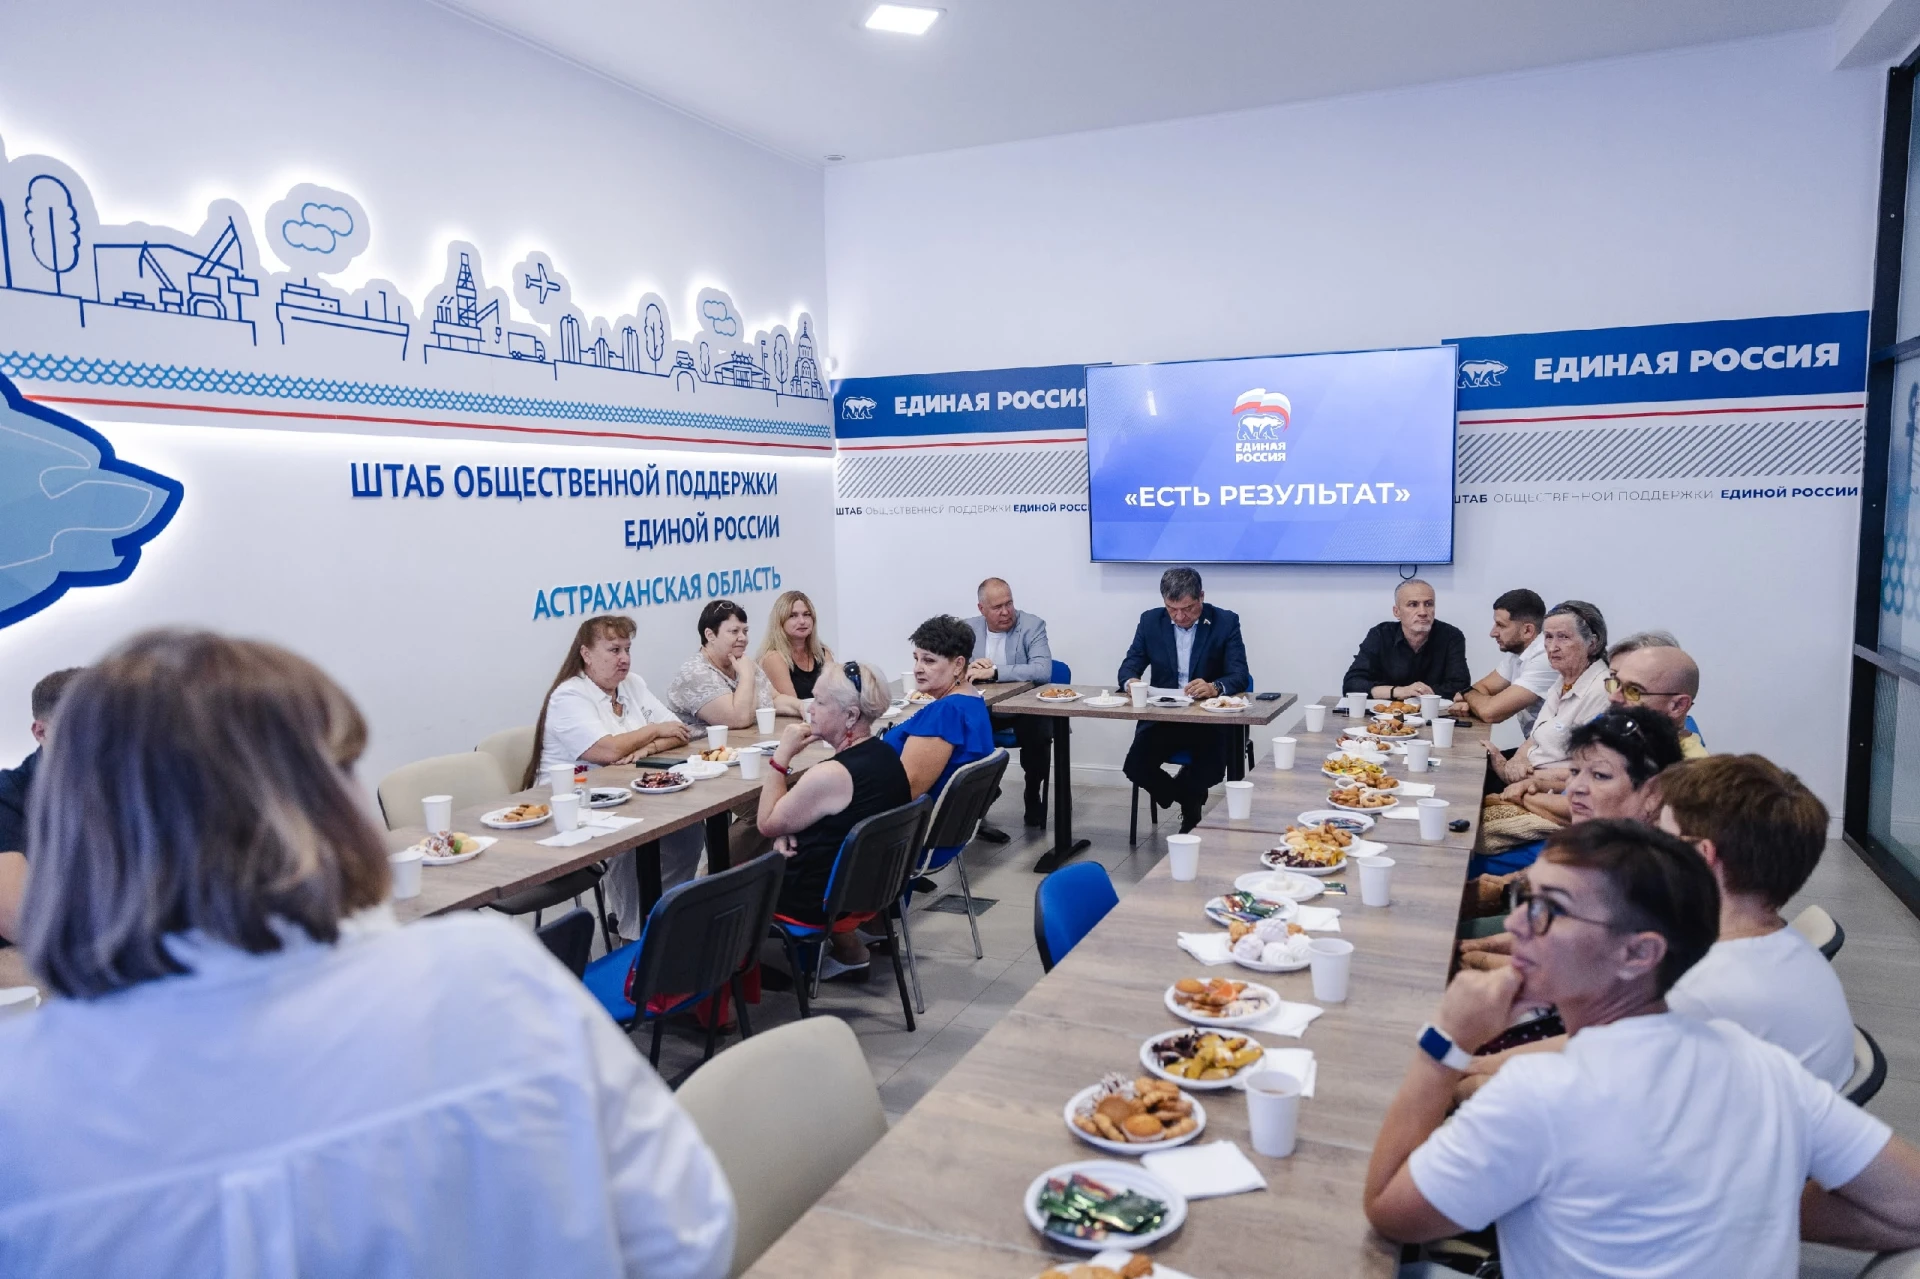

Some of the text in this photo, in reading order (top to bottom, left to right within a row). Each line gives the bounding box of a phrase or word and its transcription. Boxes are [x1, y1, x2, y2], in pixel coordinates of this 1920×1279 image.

[1534, 342, 1840, 383] ЕДИНАЯ РОССИЯ
[894, 392, 990, 417] ЕДИНАЯ
[1235, 441, 1286, 452] ЕДИНАЯ
[1235, 452, 1286, 463] РОССИЯ
[350, 461, 778, 501] ШТАБ ОБЩЕСТВЕННОЙ ПОДДЕРЖКИ
[1124, 482, 1411, 507] «ЕСТЬ РЕЗУЛЬТАТ»
[1618, 489, 1713, 502] ПОДДЕРЖКИ
[1720, 486, 1787, 500] ЕДИНОЙ
[1791, 486, 1859, 498] РОССИИ
[835, 507, 863, 516] ШТАБ
[1013, 502, 1056, 513] ЕДИНОЙ
[1059, 503, 1090, 512] РОСС
[624, 512, 780, 550] ЕДИНОЙ РОССИИ
[533, 566, 782, 620] АСТРАХАНСКАЯ ОБЛАСТЬ
